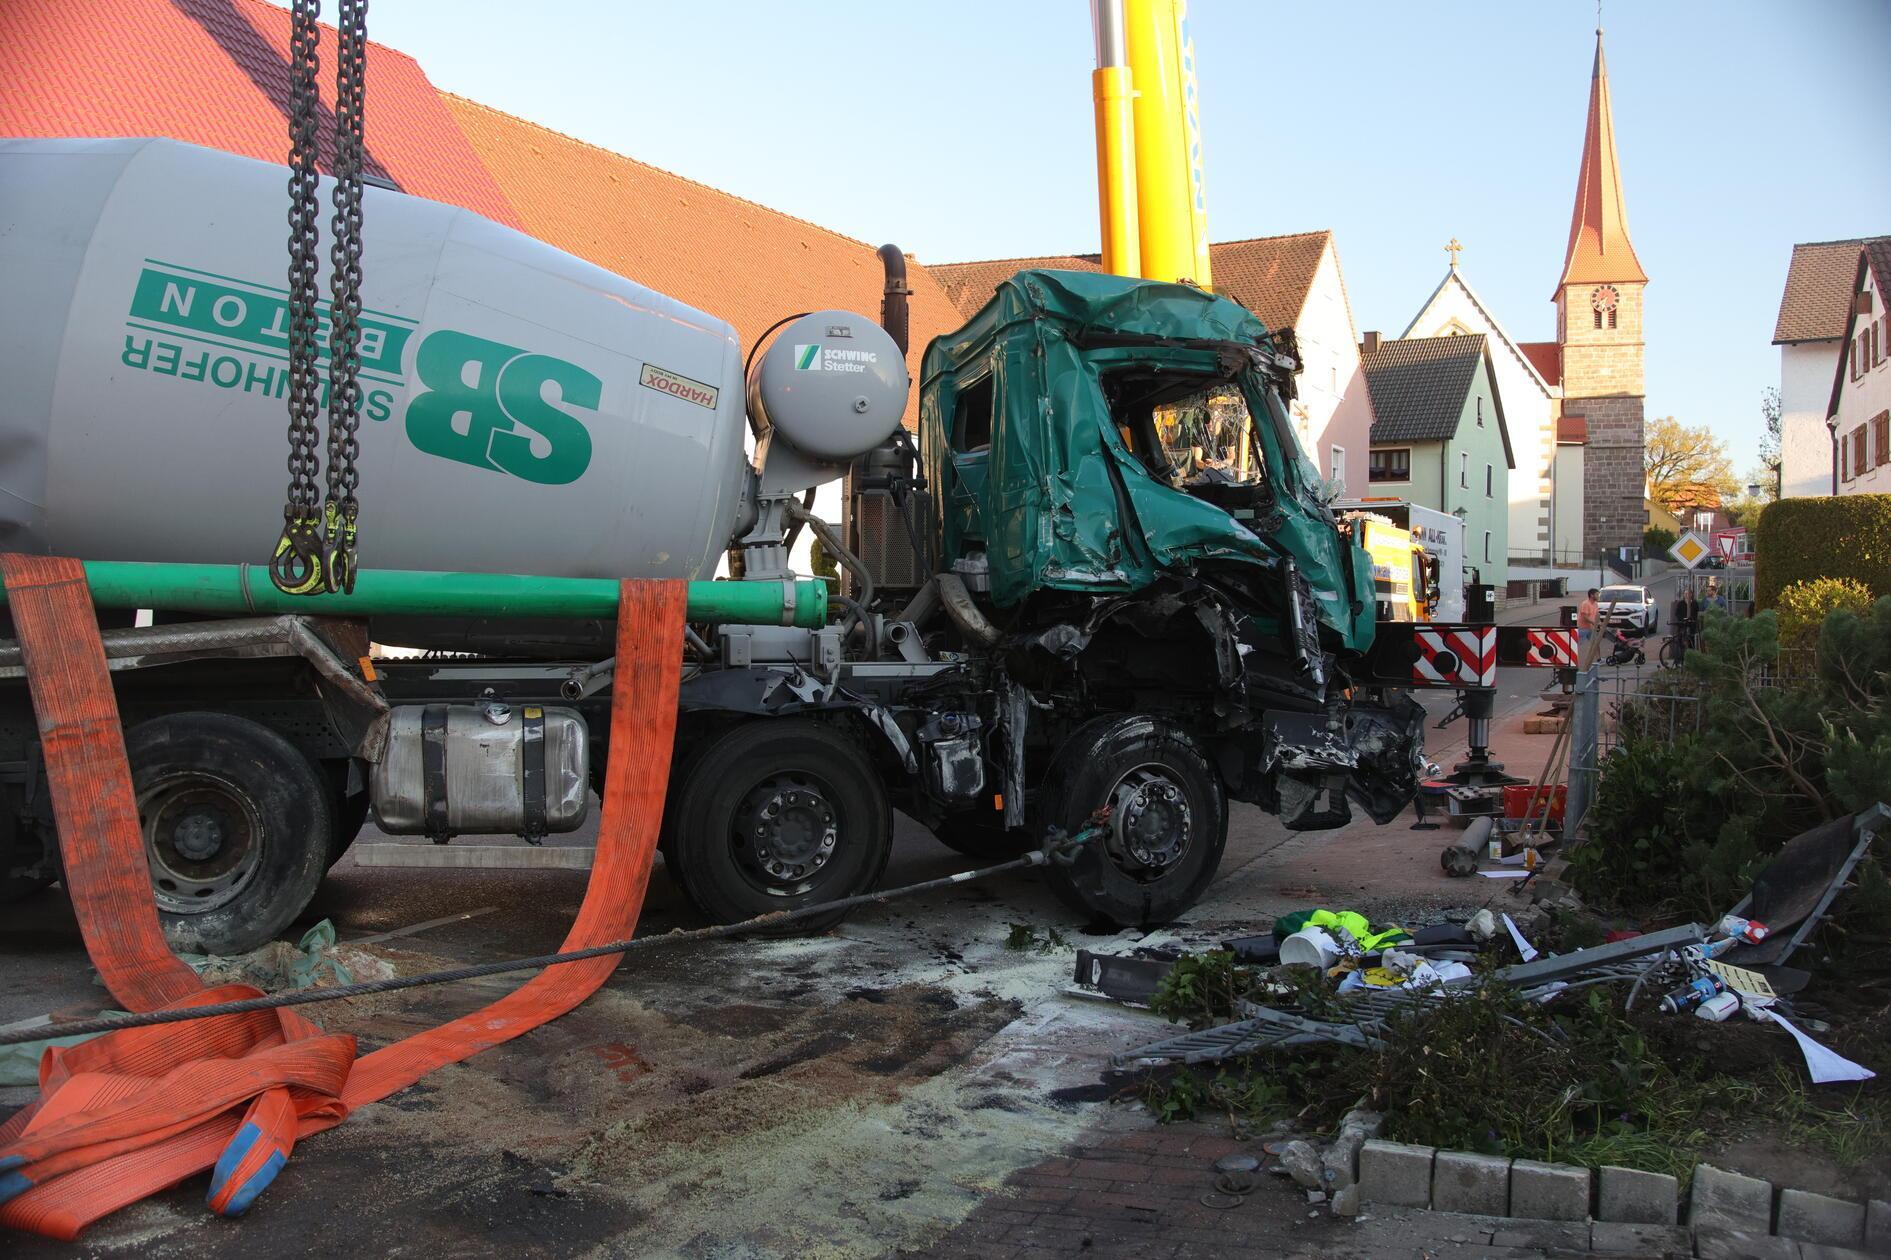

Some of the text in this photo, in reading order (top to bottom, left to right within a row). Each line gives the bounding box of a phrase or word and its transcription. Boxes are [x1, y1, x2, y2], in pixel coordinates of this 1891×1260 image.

[824, 349, 877, 363] SCHWING
[824, 362, 866, 373] Stetter
[646, 374, 713, 405] HARDOX
[405, 329, 603, 486] SB
